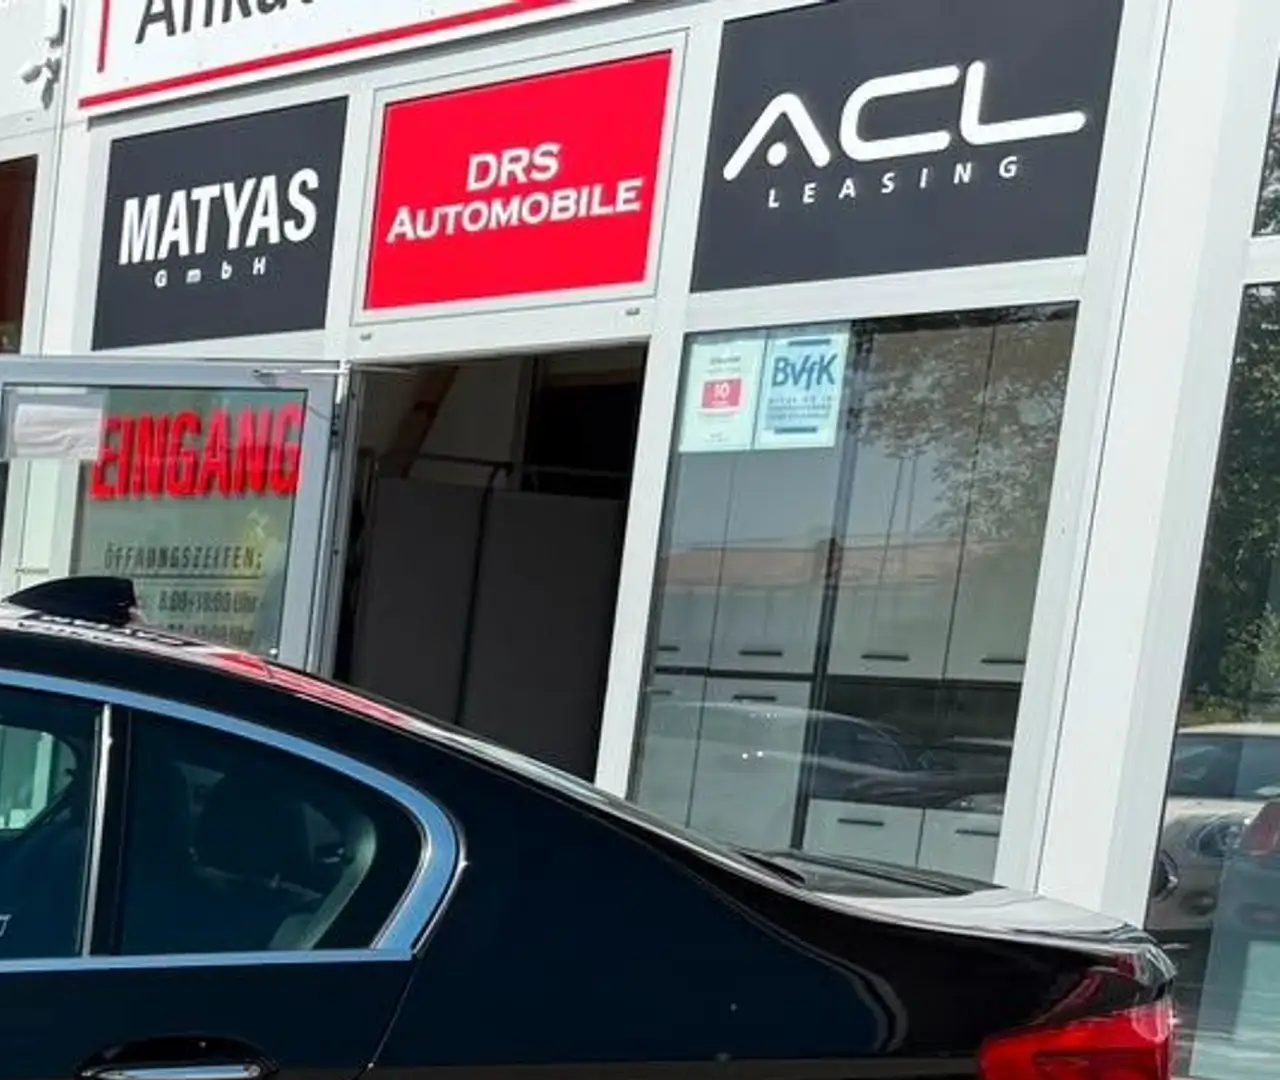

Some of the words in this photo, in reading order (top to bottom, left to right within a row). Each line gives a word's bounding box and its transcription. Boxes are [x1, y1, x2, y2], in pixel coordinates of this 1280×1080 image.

[723, 60, 1087, 181] ACL
[465, 141, 562, 192] DRS
[768, 155, 1018, 209] LEASING
[119, 168, 319, 266] MATYAS
[385, 177, 644, 244] AUTOMOBILE
[154, 256, 267, 289] GmbH
[92, 401, 308, 498] EINGANG
